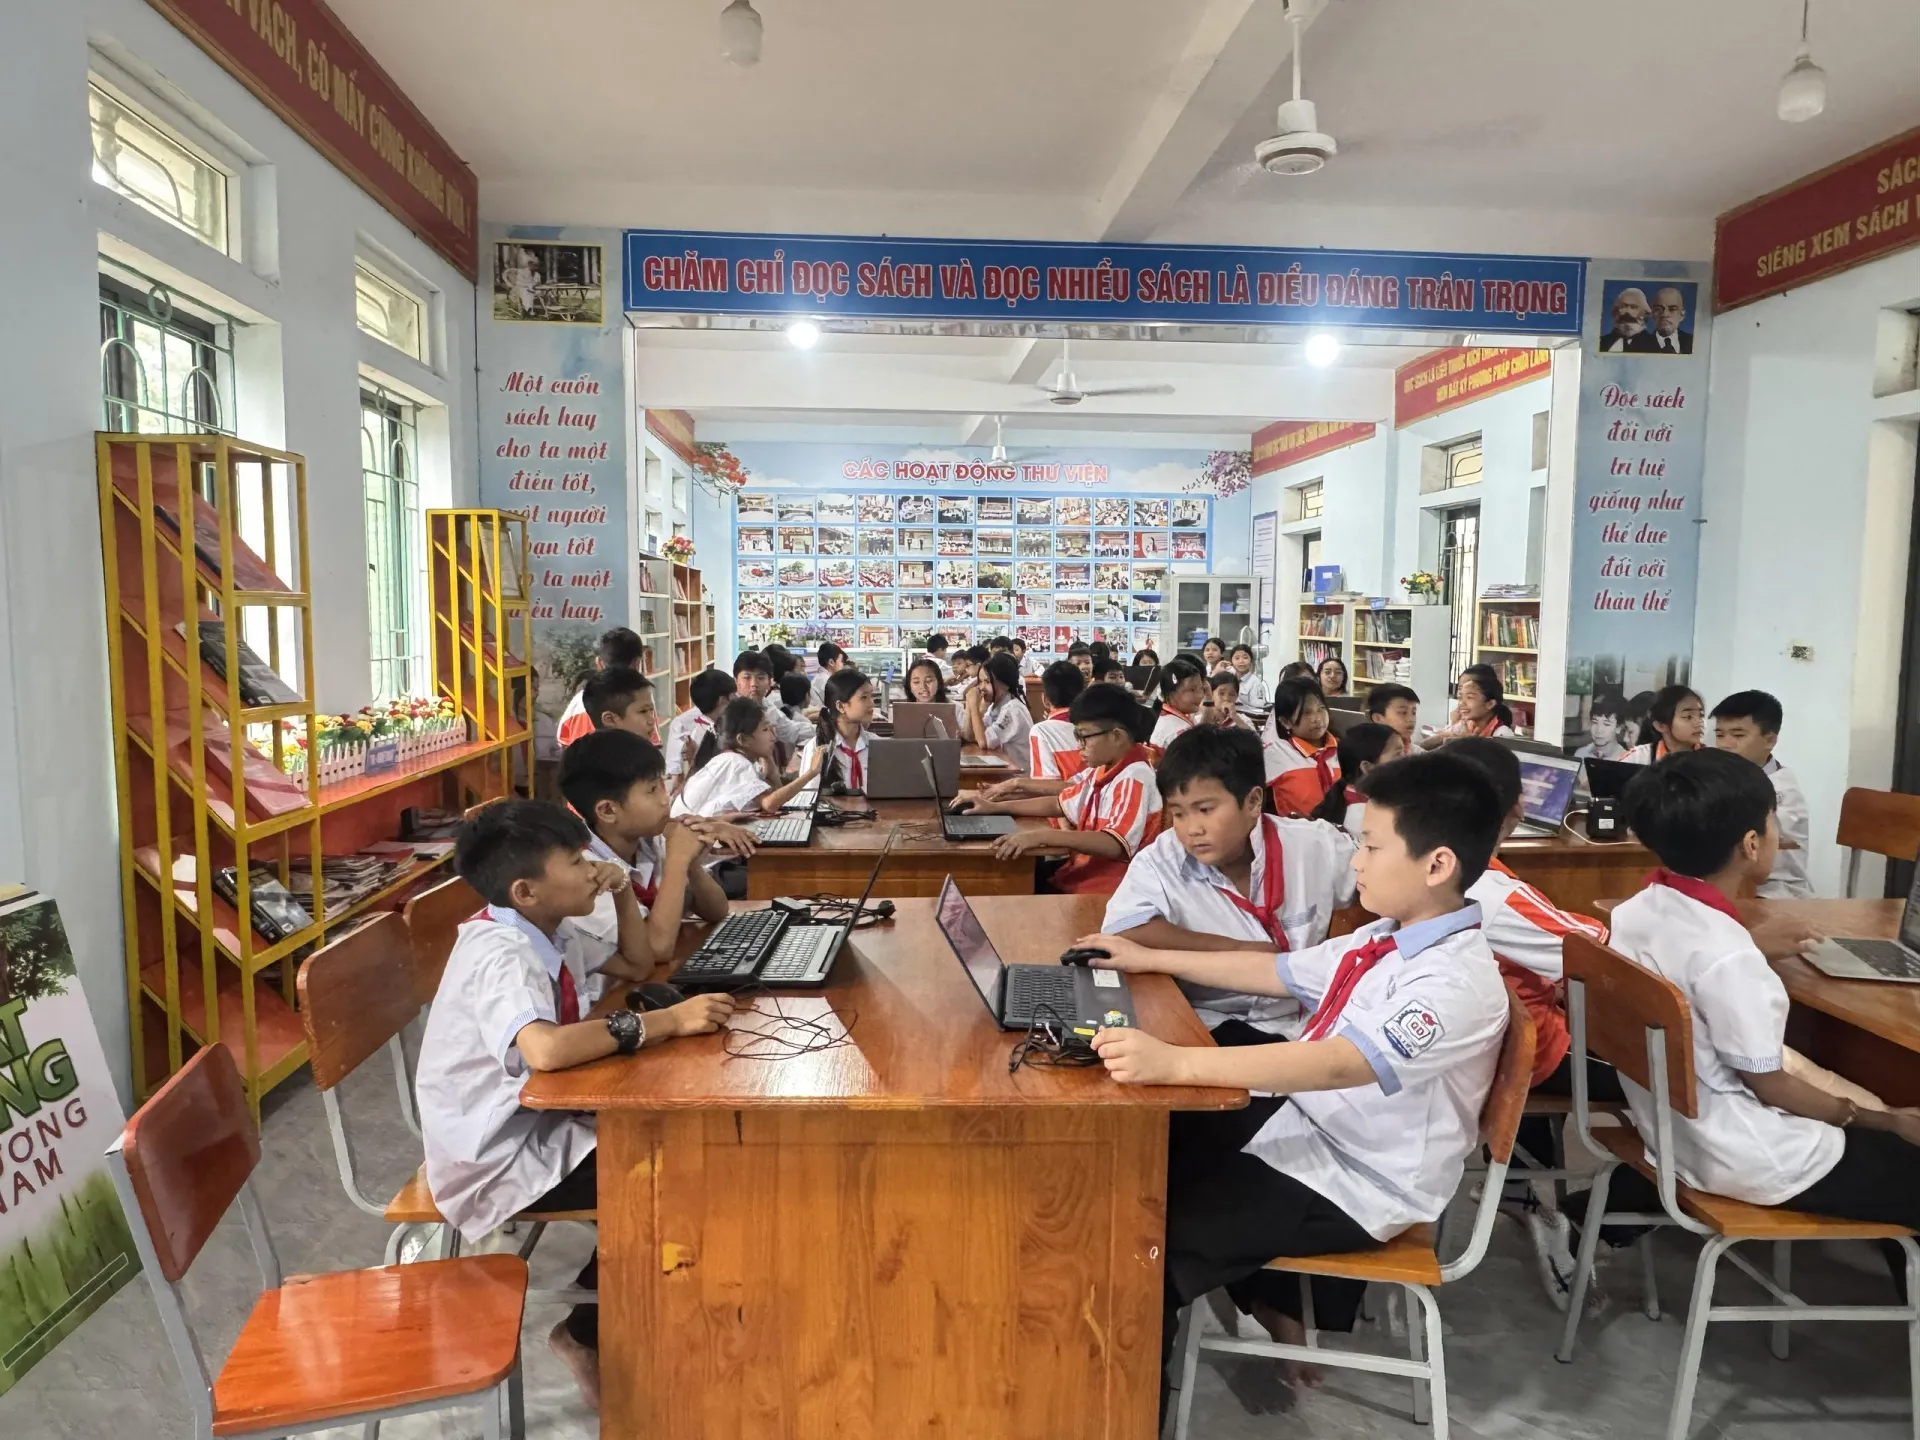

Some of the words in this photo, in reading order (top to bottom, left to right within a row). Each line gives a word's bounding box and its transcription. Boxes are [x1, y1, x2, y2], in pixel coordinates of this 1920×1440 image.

[1810, 220, 1851, 258] XEM
[1856, 199, 1909, 241] SÁCH
[643, 250, 728, 293] CHĂM
[736, 249, 784, 295] CHỈ
[791, 260, 849, 303] ĐỌC
[857, 256, 933, 298] SÁCH
[939, 257, 977, 299] VÀ
[983, 265, 1040, 307] ĐỌC
[1047, 257, 1130, 301] NHIỀU
[1137, 262, 1210, 304] SÁCH
[1217, 264, 1251, 305] LÀ
[1257, 262, 1319, 306] ĐIỀU
[1325, 268, 1399, 309] ĐÁNG
[1405, 271, 1475, 312] TRÂN
[1481, 279, 1567, 320] TRỌNG
[500, 371, 544, 397] Một
[1600, 384, 1638, 411] Đọc
[1644, 387, 1685, 408] sách
[505, 405, 550, 426] sách
[557, 406, 597, 431] hay
[1607, 420, 1639, 441] đối
[1645, 423, 1673, 441] với
[496, 437, 531, 458] cho
[539, 441, 560, 459] ta
[567, 442, 608, 463] một
[508, 469, 554, 491] điều
[561, 472, 595, 494] tốt,
[842, 457, 890, 479] CÁC
[894, 461, 950, 485] HOẠT
[954, 458, 1016, 486] ĐỘNG
[1021, 462, 1060, 482] THƯ
[1064, 461, 1108, 487] VIỆN
[1589, 489, 1641, 514] giống
[1647, 489, 1685, 510] như
[547, 506, 606, 528] người
[567, 537, 595, 556] tốt
[1602, 521, 1632, 543] thể
[1635, 522, 1668, 548] dục
[1601, 555, 1632, 577] đối
[543, 570, 564, 587] ta
[571, 570, 611, 591] một
[561, 599, 604, 622] hay.
[1642, 589, 1672, 611] thể
[0, 1097, 88, 1177] ƠNG
